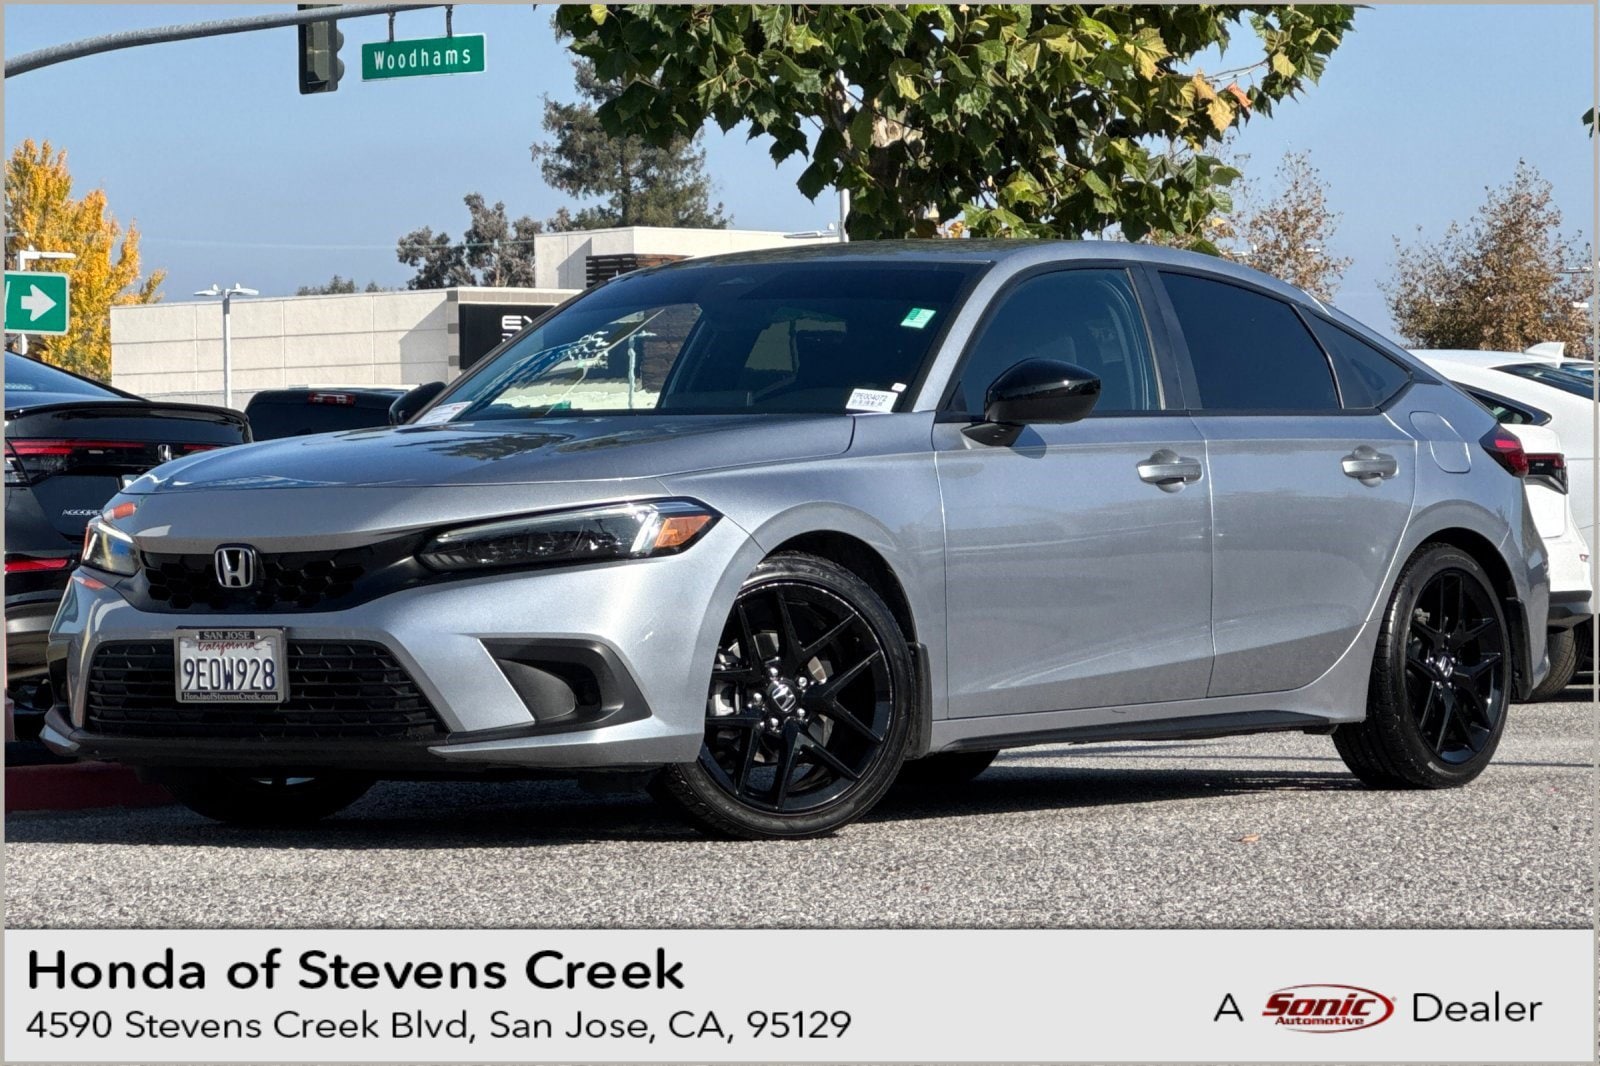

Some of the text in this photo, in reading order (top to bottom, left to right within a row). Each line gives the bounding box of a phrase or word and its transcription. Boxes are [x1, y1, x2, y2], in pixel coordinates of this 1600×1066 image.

[374, 47, 471, 70] Woodhams
[203, 631, 251, 640] SAN JOSE
[184, 658, 275, 690] 9EOW928
